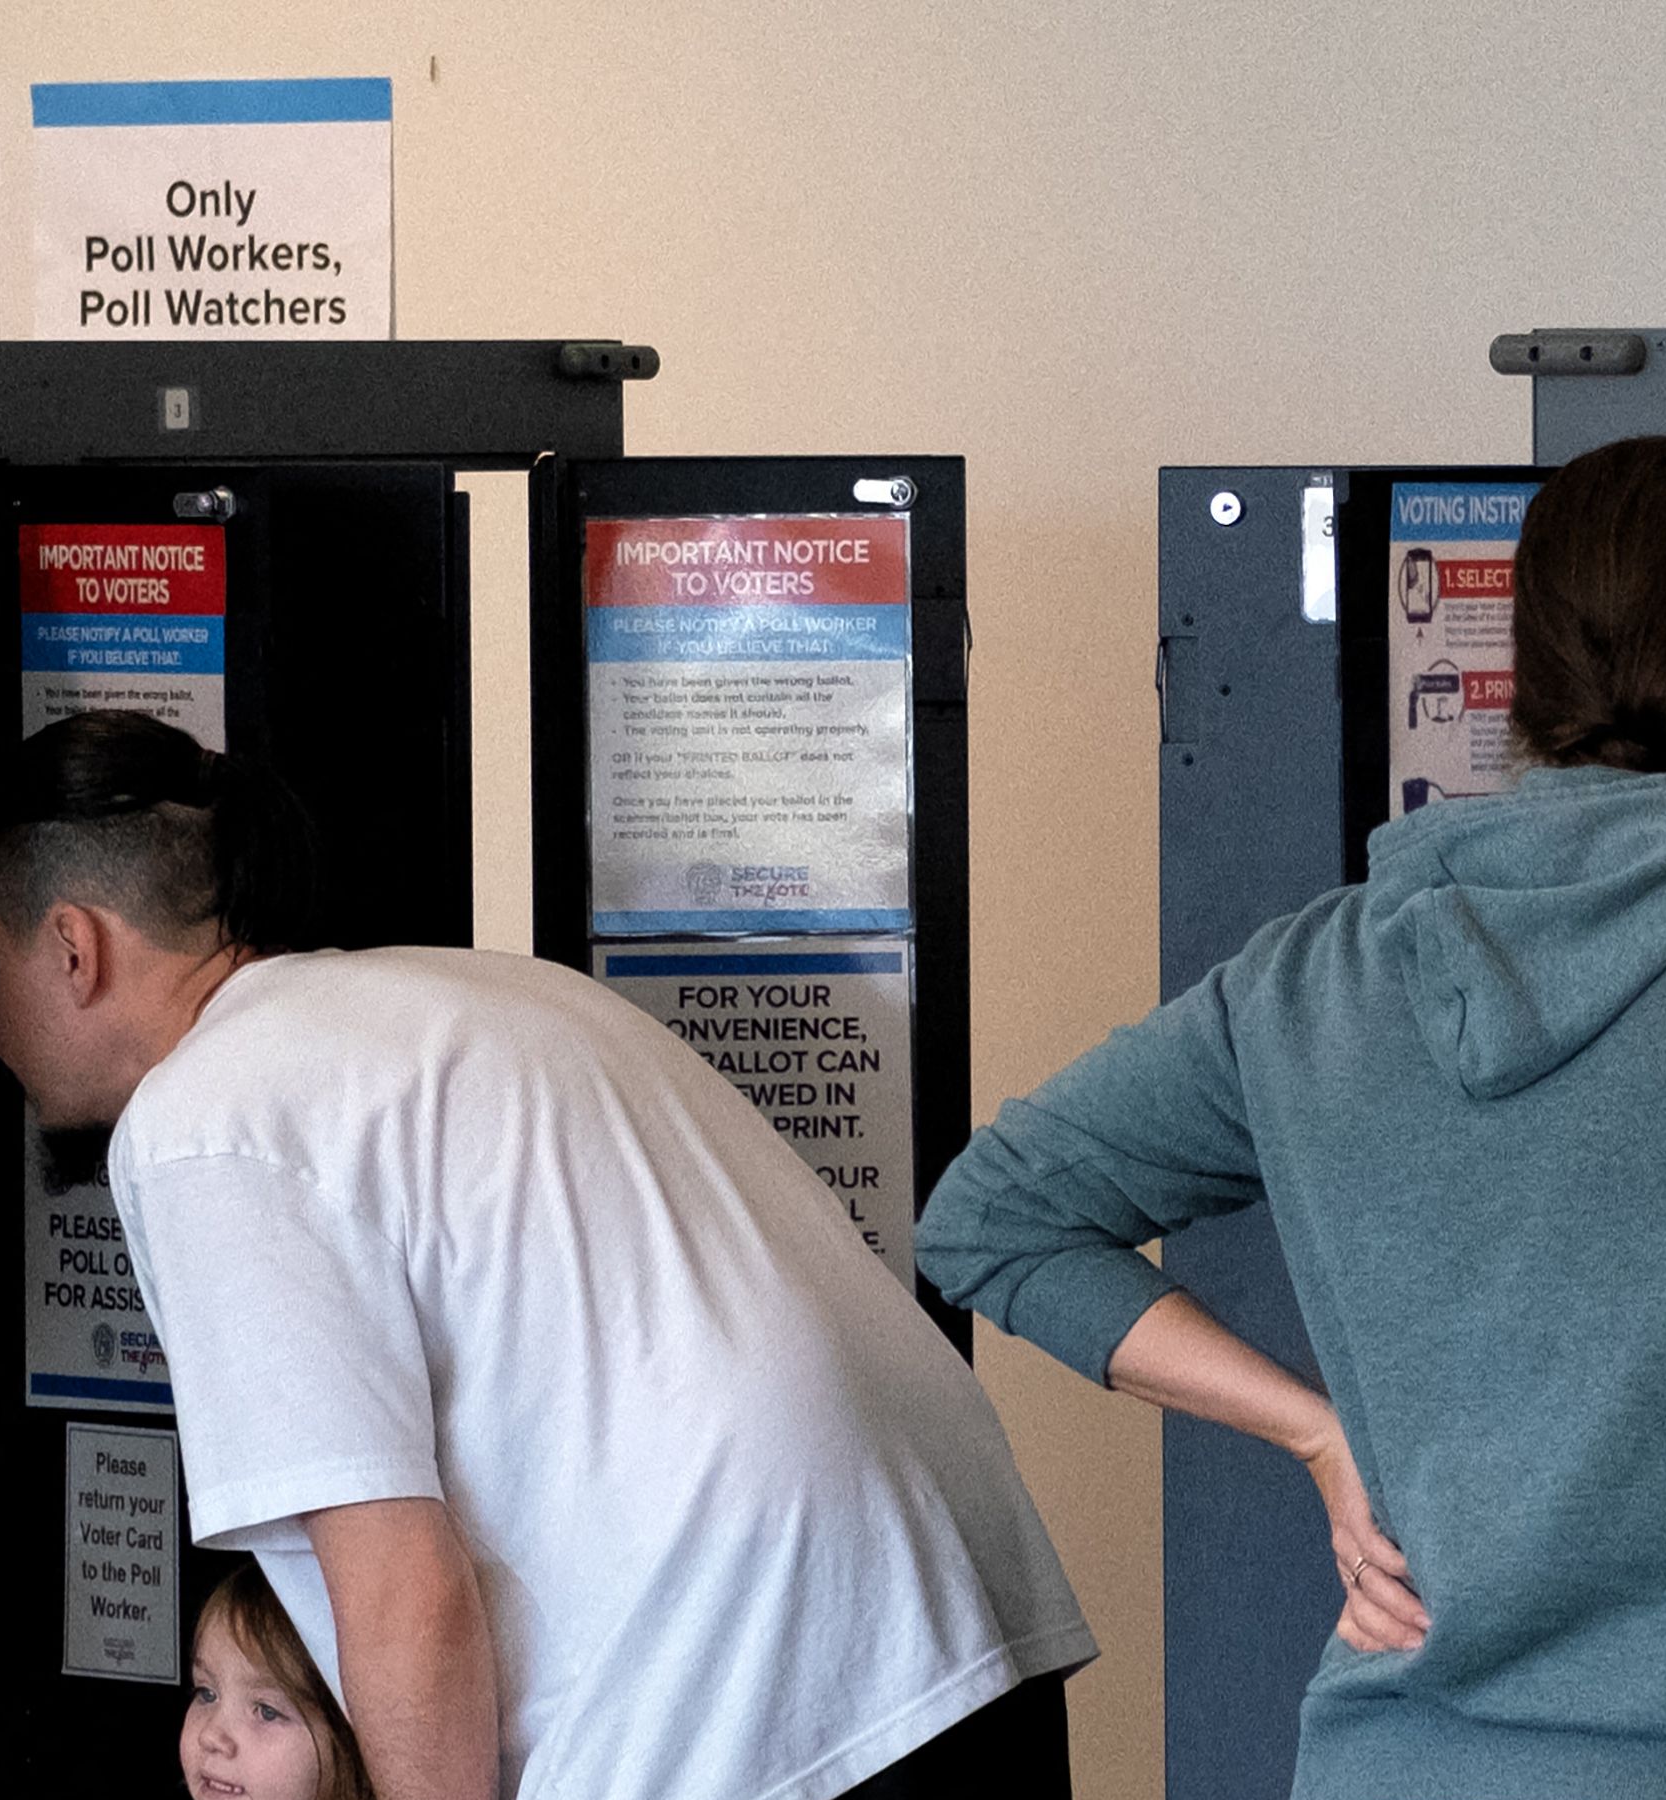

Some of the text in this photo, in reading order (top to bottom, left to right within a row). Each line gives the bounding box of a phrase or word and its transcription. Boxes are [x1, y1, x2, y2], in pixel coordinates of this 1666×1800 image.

[165, 180, 256, 226] Only
[86, 234, 342, 276] Poll Workers,
[80, 289, 347, 327] Poll Watchers
[173, 403, 182, 419] 3
[1398, 496, 1464, 525] VOTING
[39, 545, 205, 571] IMPORTANT NOTICE
[617, 540, 870, 566] IMPORTANT NOTICE
[76, 578, 170, 604] TO VOTERS
[672, 571, 814, 596] TO VOTERS
[1444, 571, 1512, 589] 1. SELECT
[38, 626, 208, 643] PLEASE NOTIFY A POLL WORKER
[613, 617, 876, 633] PLEASE NOTIFY A POLL WORKER
[653, 691, 687, 703] ballot
[691, 692, 720, 703] does
[724, 692, 744, 703] not
[748, 692, 792, 703] contain
[797, 691, 810, 702] all
[813, 691, 832, 702] the
[1470, 682, 1483, 700] 2.
[625, 724, 646, 736] The
[650, 724, 688, 739] voting
[692, 724, 716, 736] unit
[719, 724, 728, 736] is
[732, 725, 751, 736] not
[754, 724, 813, 739] operating
[612, 794, 853, 809] Once you have placed your ballot in the
[731, 866, 809, 882] SECURE
[679, 986, 831, 1009] FOR YOUR
[666, 1017, 868, 1043] ONVENIENCE,
[817, 1050, 880, 1073] CAN
[826, 1083, 855, 1106] IN
[773, 1116, 864, 1139] PRINT.
[50, 1214, 122, 1242] PLEASE
[60, 1249, 109, 1275] POLL
[45, 1283, 146, 1312] FOR ASSIS
[95, 1452, 147, 1479] Please
[78, 1491, 165, 1517] return your
[80, 1522, 163, 1552] Voter Card
[82, 1561, 161, 1587] to the Poll
[90, 1595, 151, 1623] Worker.
